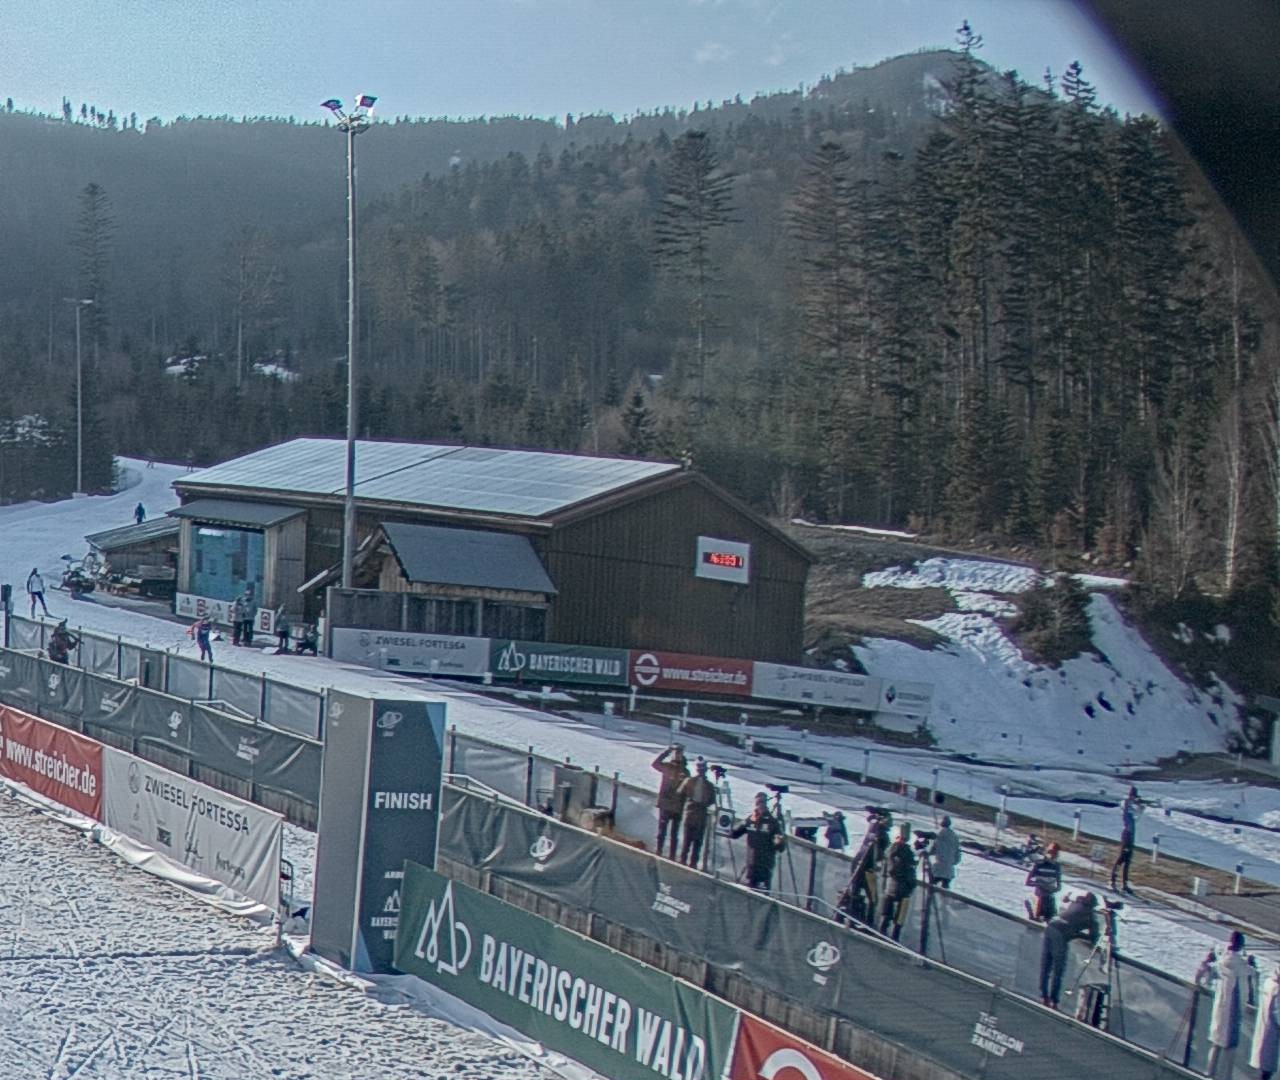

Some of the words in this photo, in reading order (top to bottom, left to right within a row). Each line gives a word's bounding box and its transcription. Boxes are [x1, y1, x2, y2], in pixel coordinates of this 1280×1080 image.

[529, 653, 592, 675] BAYERISCHER
[594, 658, 621, 676] WALD
[662, 666, 748, 686] www.streicher.de
[5, 738, 97, 797] www.streicher.de
[144, 775, 190, 810] ZWIESEL
[191, 794, 251, 836] FORTESSA
[374, 791, 433, 811] FINISH
[480, 934, 631, 1054] BAYERISCHER
[971, 1033, 1008, 1057] FAMILY
[974, 1022, 1025, 1053] BIATHLON
